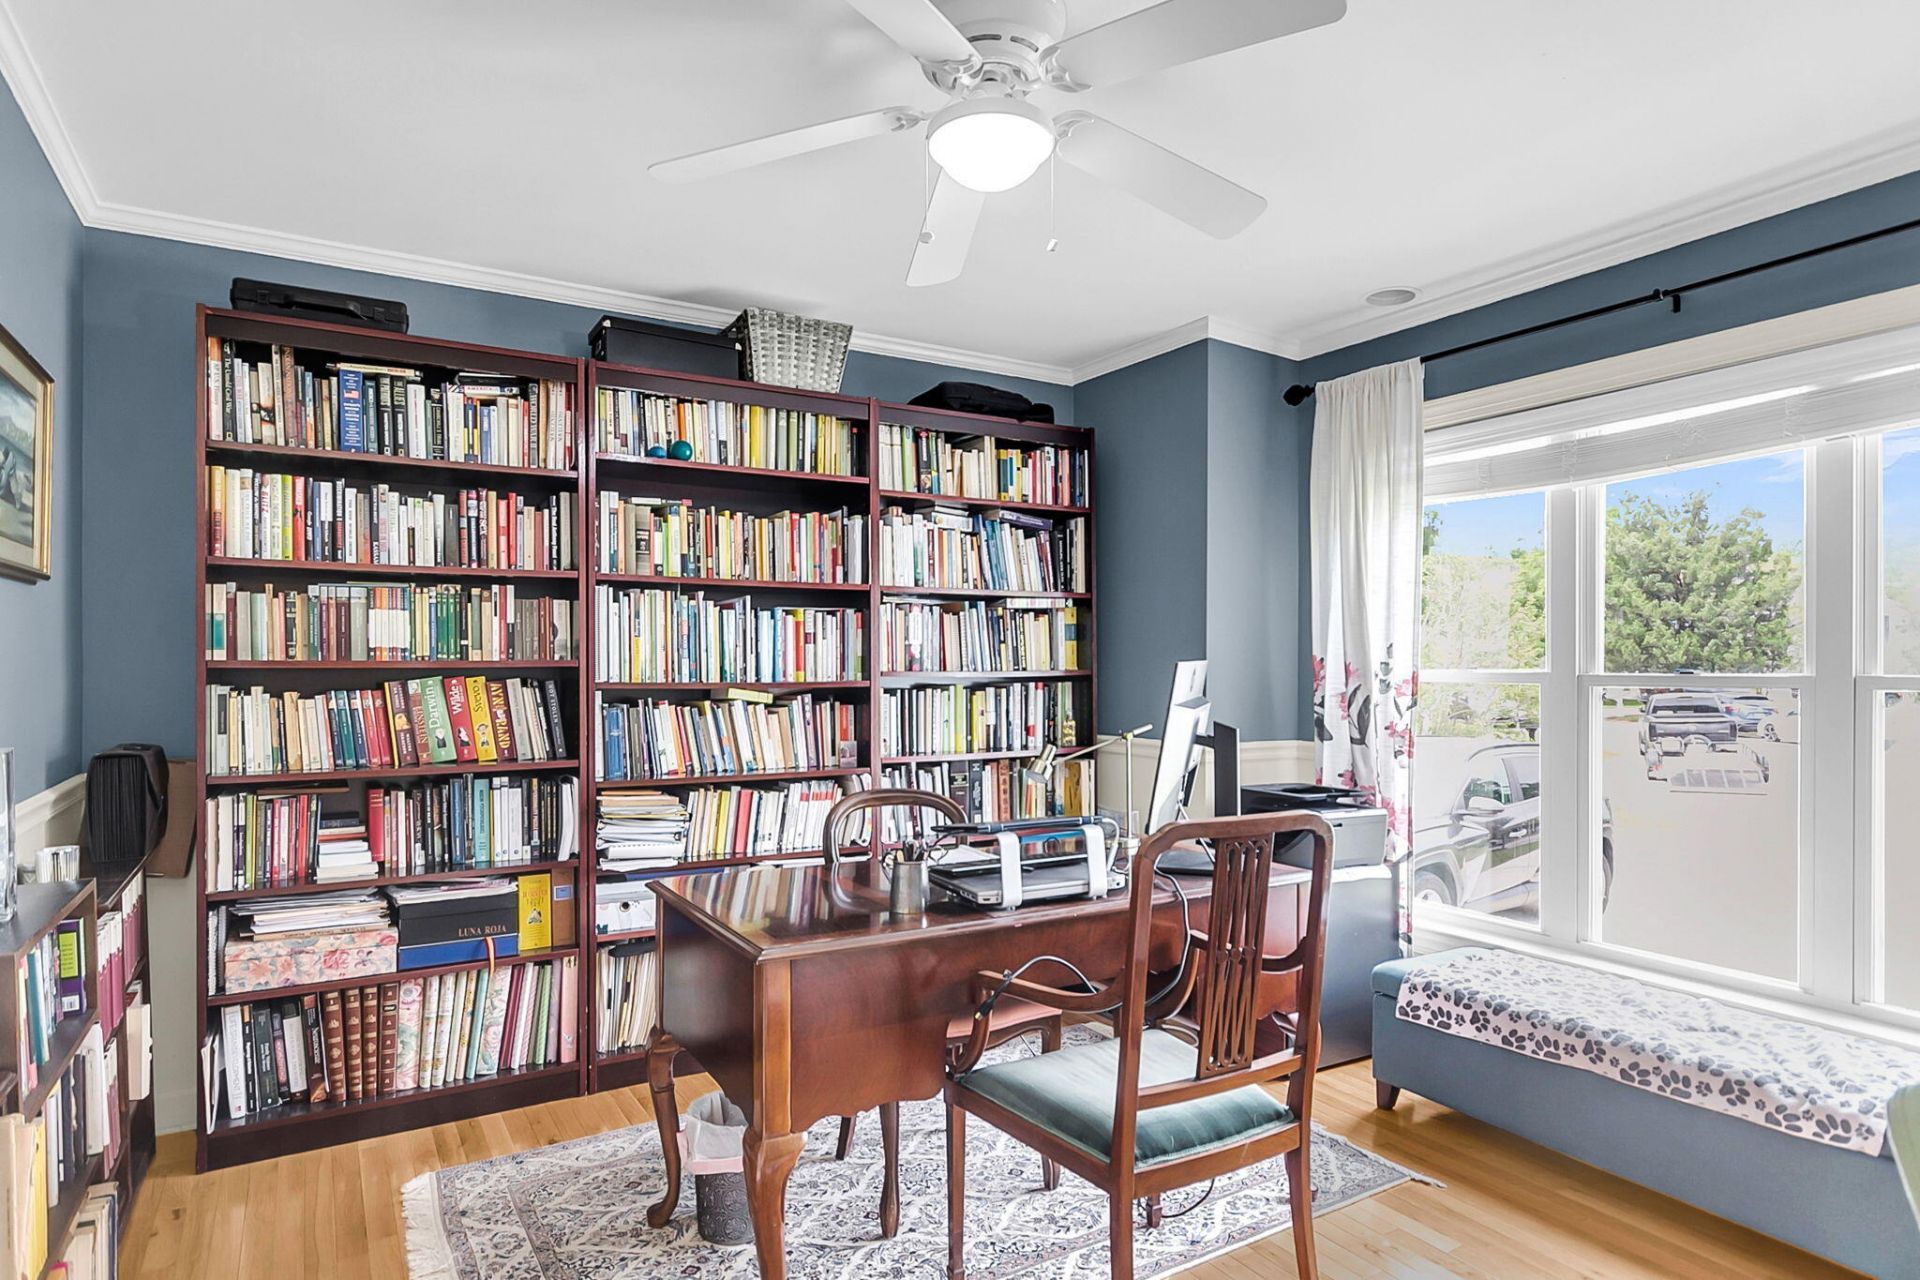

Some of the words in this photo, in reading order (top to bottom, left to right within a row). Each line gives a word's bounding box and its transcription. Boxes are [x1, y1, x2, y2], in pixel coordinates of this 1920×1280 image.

[394, 386, 405, 405] ALLIES
[425, 687, 440, 729] Darwin
[449, 685, 463, 714] Wilde
[490, 684, 505, 705] AYN
[413, 706, 429, 744] EINSTEIN
[496, 719, 510, 748] RAND
[458, 928, 481, 937] LUNA
[484, 925, 506, 934] ROJA
[312, 1026, 320, 1064] Neuroscience
